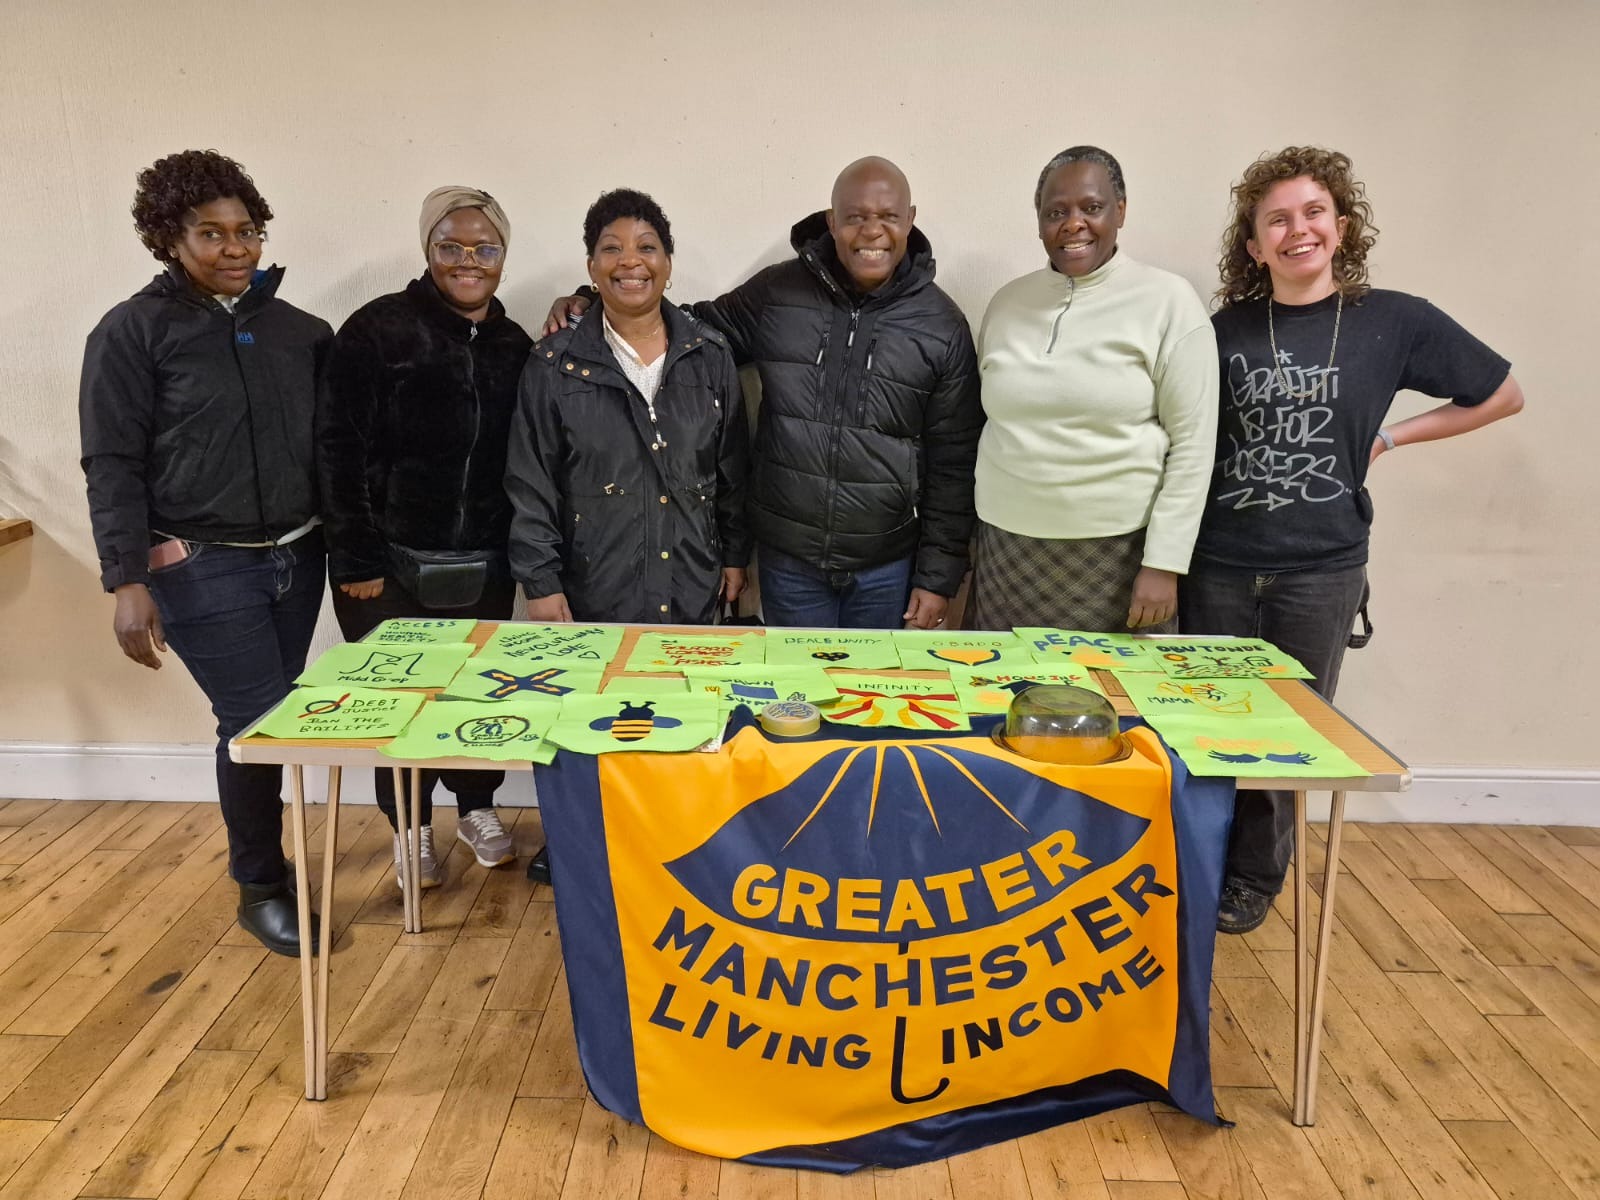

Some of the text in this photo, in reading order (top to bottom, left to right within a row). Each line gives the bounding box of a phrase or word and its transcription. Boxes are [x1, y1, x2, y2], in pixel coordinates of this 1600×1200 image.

[1239, 405, 1334, 447] IS FOR
[1225, 434, 1345, 502] LOSERS
[838, 637, 882, 645] UNITY
[1033, 633, 1139, 657] PEACE
[858, 682, 934, 692] INFINITY
[351, 698, 401, 708] DEBT
[1147, 696, 1196, 705] MAMA
[341, 705, 398, 714] JUSTICE
[299, 723, 390, 733] BAILIFFS
[732, 829, 1093, 932] GREATER
[652, 863, 1175, 1010] MANCHESTER
[648, 945, 1166, 1070] LIVING INCOME
